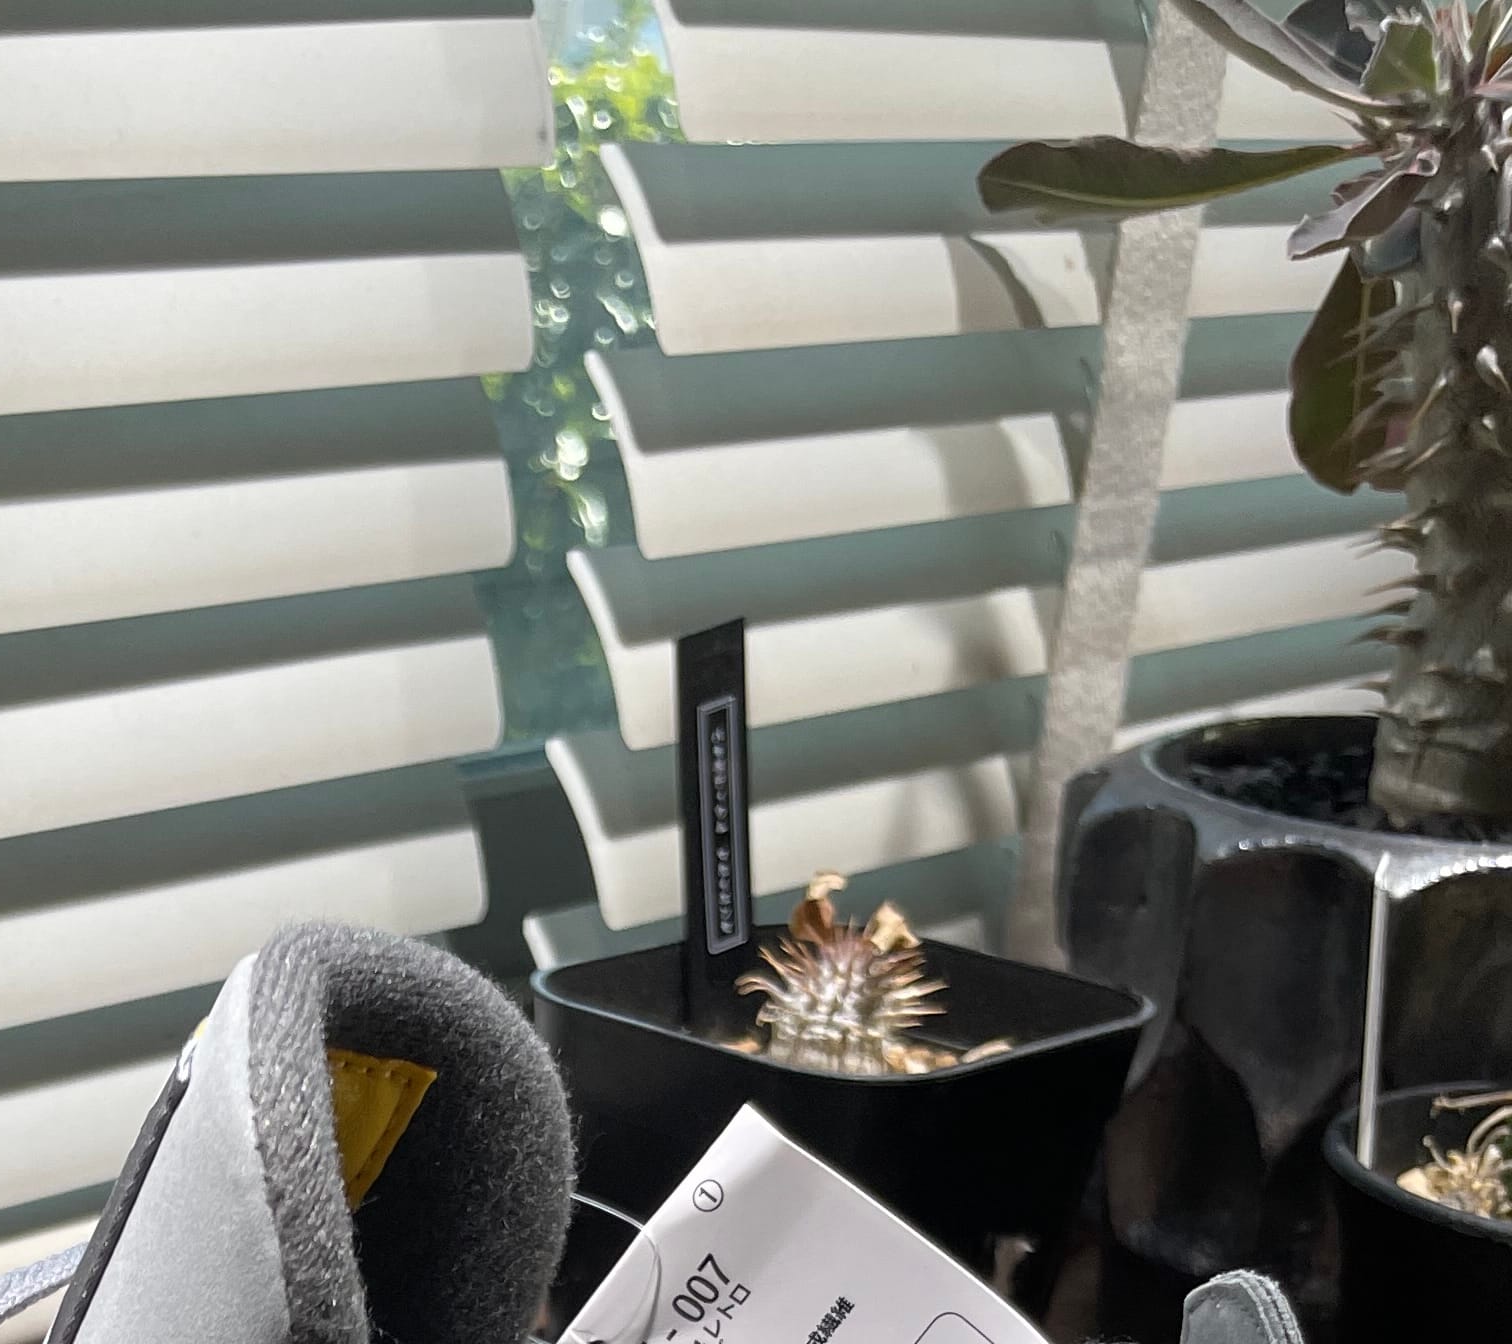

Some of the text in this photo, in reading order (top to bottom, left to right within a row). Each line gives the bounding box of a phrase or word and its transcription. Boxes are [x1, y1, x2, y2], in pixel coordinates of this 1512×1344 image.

[672, 1253, 730, 1322] 007
[703, 1283, 751, 1338] レトロ
